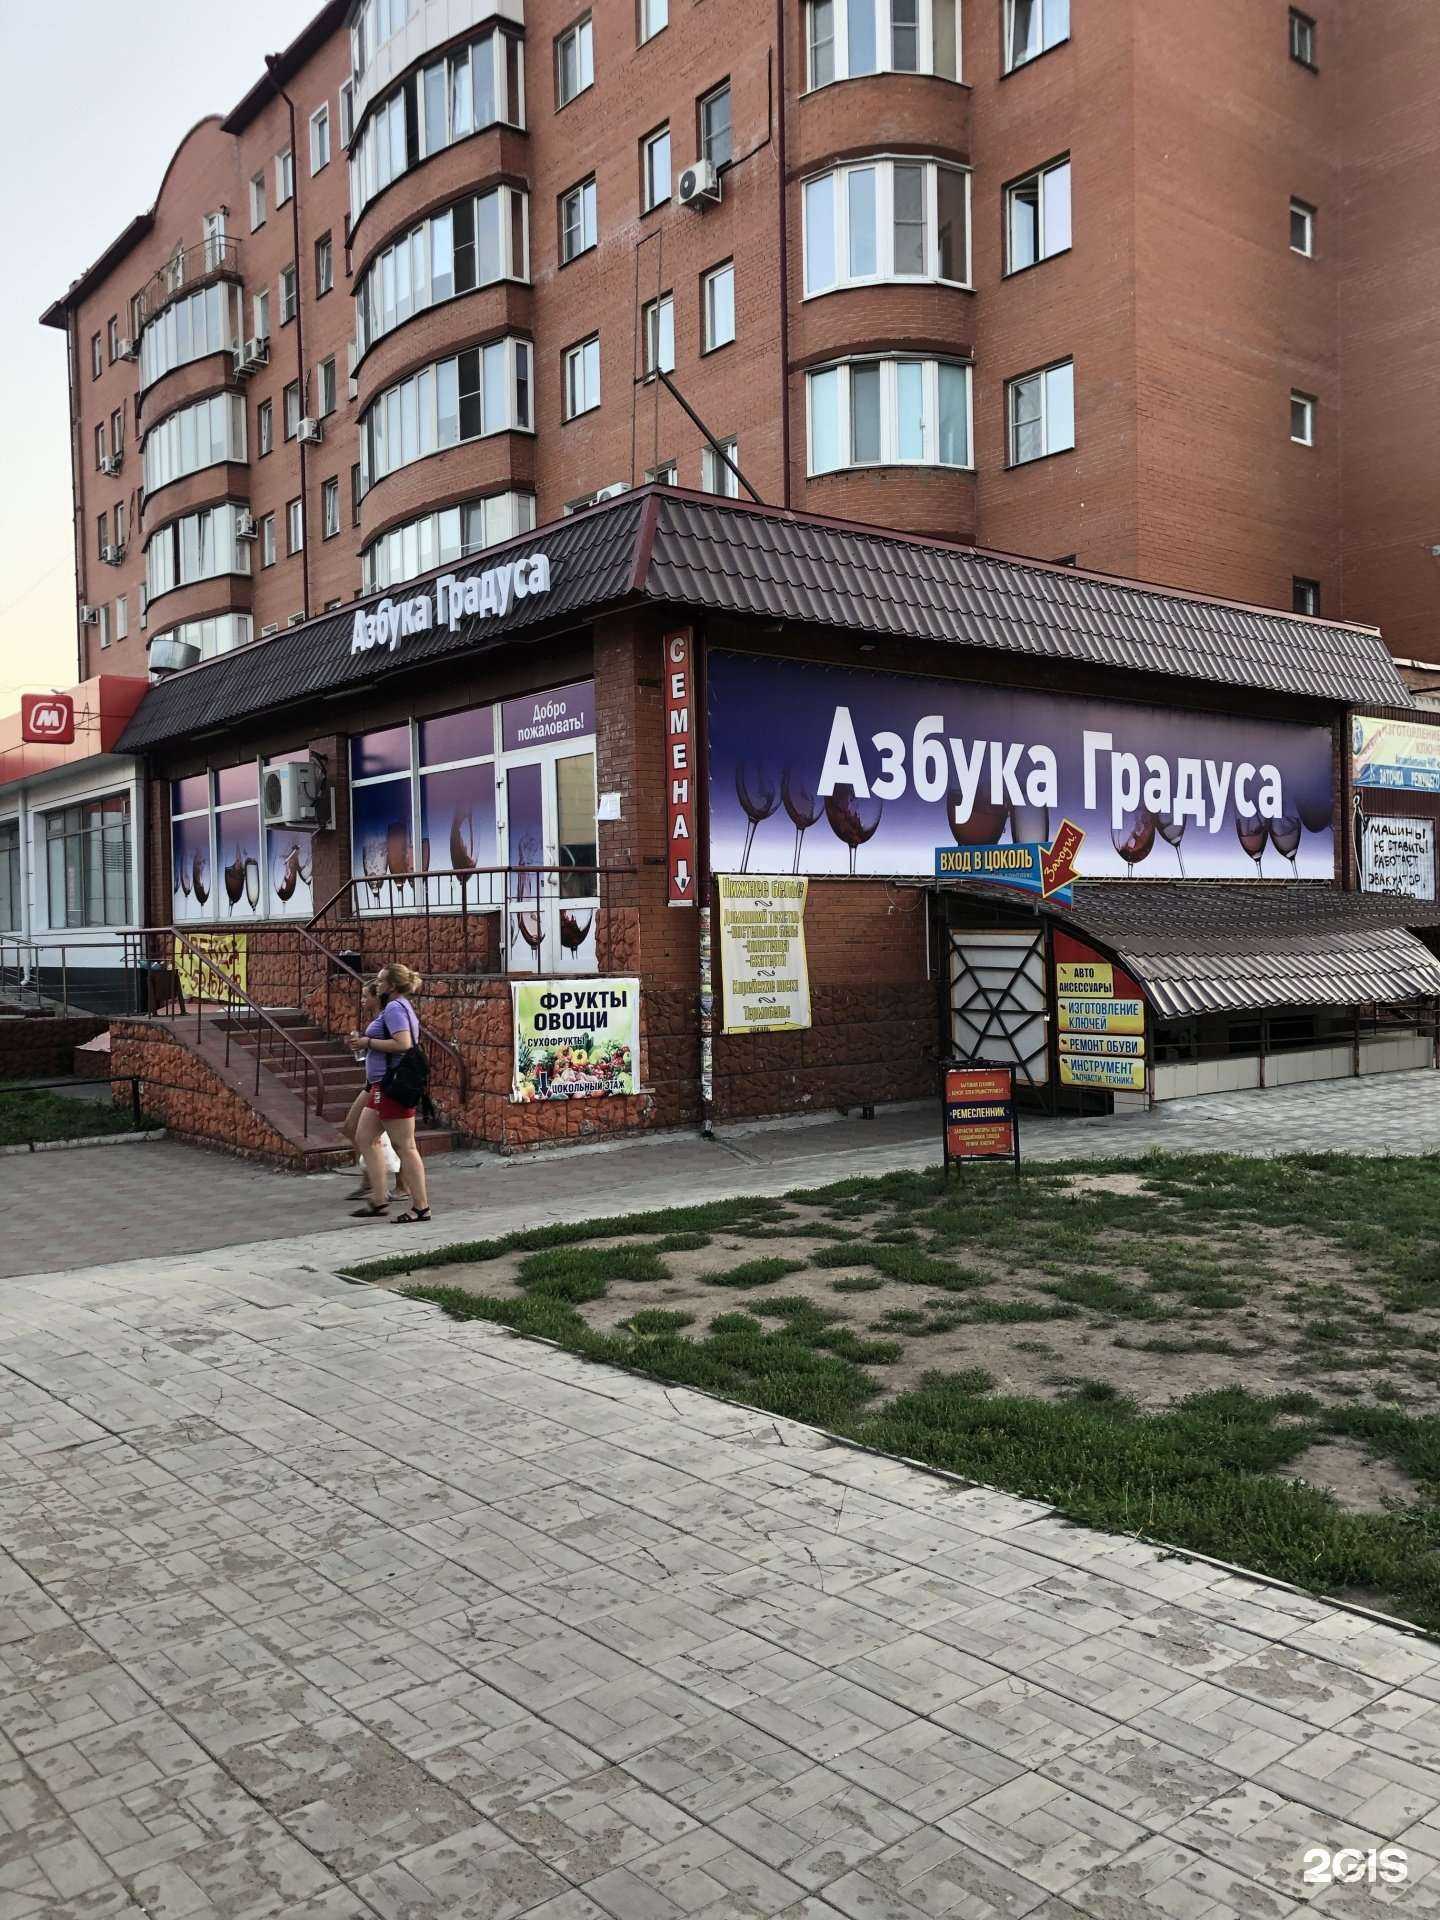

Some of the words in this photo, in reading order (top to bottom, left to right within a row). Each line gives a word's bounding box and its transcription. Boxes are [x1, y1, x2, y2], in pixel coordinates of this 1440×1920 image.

[351, 595, 433, 655] Азбука
[436, 553, 551, 632] Градуса
[533, 700, 567, 724] Добро
[518, 712, 584, 742] пожаловать!
[669, 637, 689, 839] СЕМЕНА
[816, 706, 1058, 825] Азбука
[1083, 730, 1283, 834] Градуса
[1380, 769, 1404, 785] ЗАТОЧКА
[1370, 824, 1426, 840] МАШИНЫ
[1043, 827, 1076, 882] Заходи!
[1374, 840, 1384, 852] НЕ
[1388, 840, 1428, 854] СТАВИТЬ!
[940, 852, 971, 873] ВХОД
[974, 852, 982, 870] В
[984, 849, 1033, 872] ЦОКОЛЬ
[1374, 855, 1418, 868] РАБОТАЕТ
[1074, 967, 1094, 978] АВТО
[539, 990, 628, 1010] ФРУКТЫ
[1068, 1002, 1139, 1016] ИЗГОТОВЛЕНИЕ
[534, 1011, 608, 1032] ОВОЩИ
[1068, 1016, 1107, 1030] КЛЮЧЕЙ
[527, 1036, 585, 1048] СУХОФРУКТЫ
[1069, 1038, 1104, 1052] РЕМОНТ
[1106, 1040, 1138, 1054] ОБУВИ
[1071, 1058, 1134, 1075] ИНСТРУМЕНТ
[552, 1081, 603, 1094] ЦОКОЛЬНЫЙ
[604, 1079, 625, 1091] ЭТАЖ
[1105, 1075, 1135, 1086] ТЕХНИКА
